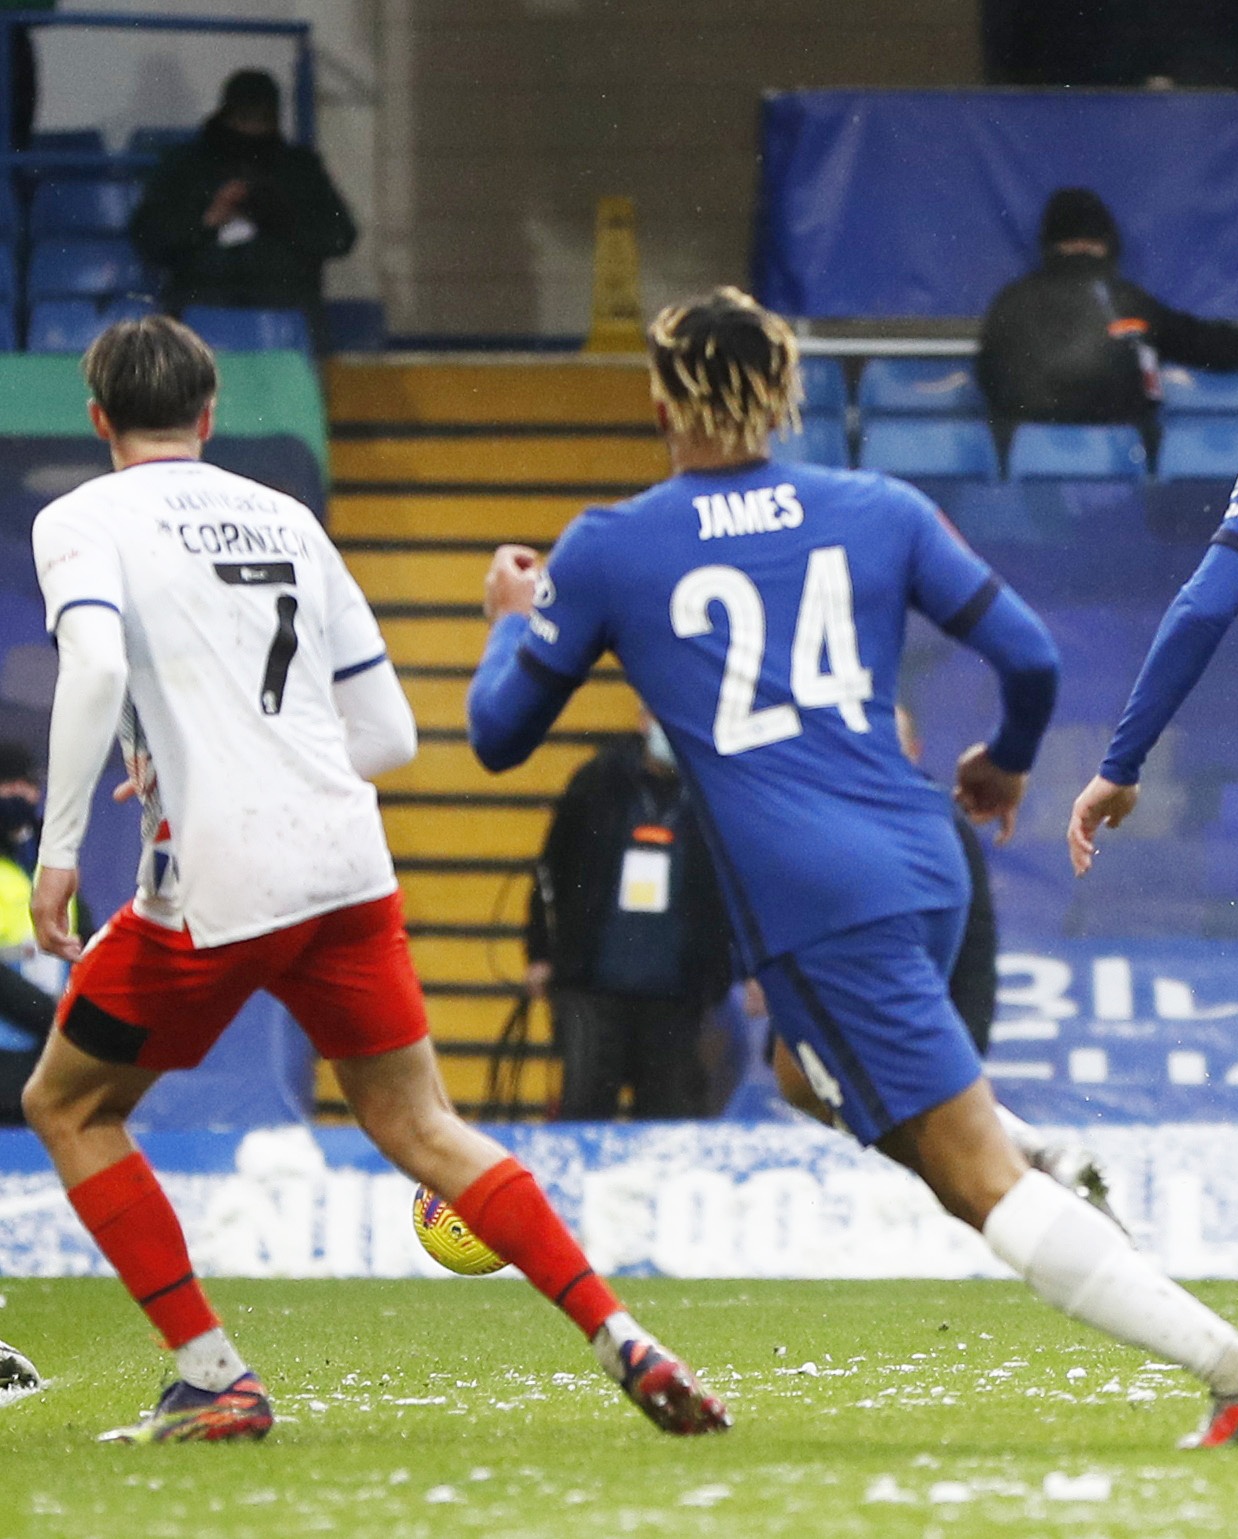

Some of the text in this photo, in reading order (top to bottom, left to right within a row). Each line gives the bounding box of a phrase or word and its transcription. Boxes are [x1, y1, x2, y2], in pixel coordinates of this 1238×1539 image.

[692, 482, 804, 541] JAMES
[212, 562, 298, 716] 7
[668, 544, 874, 757] 24
